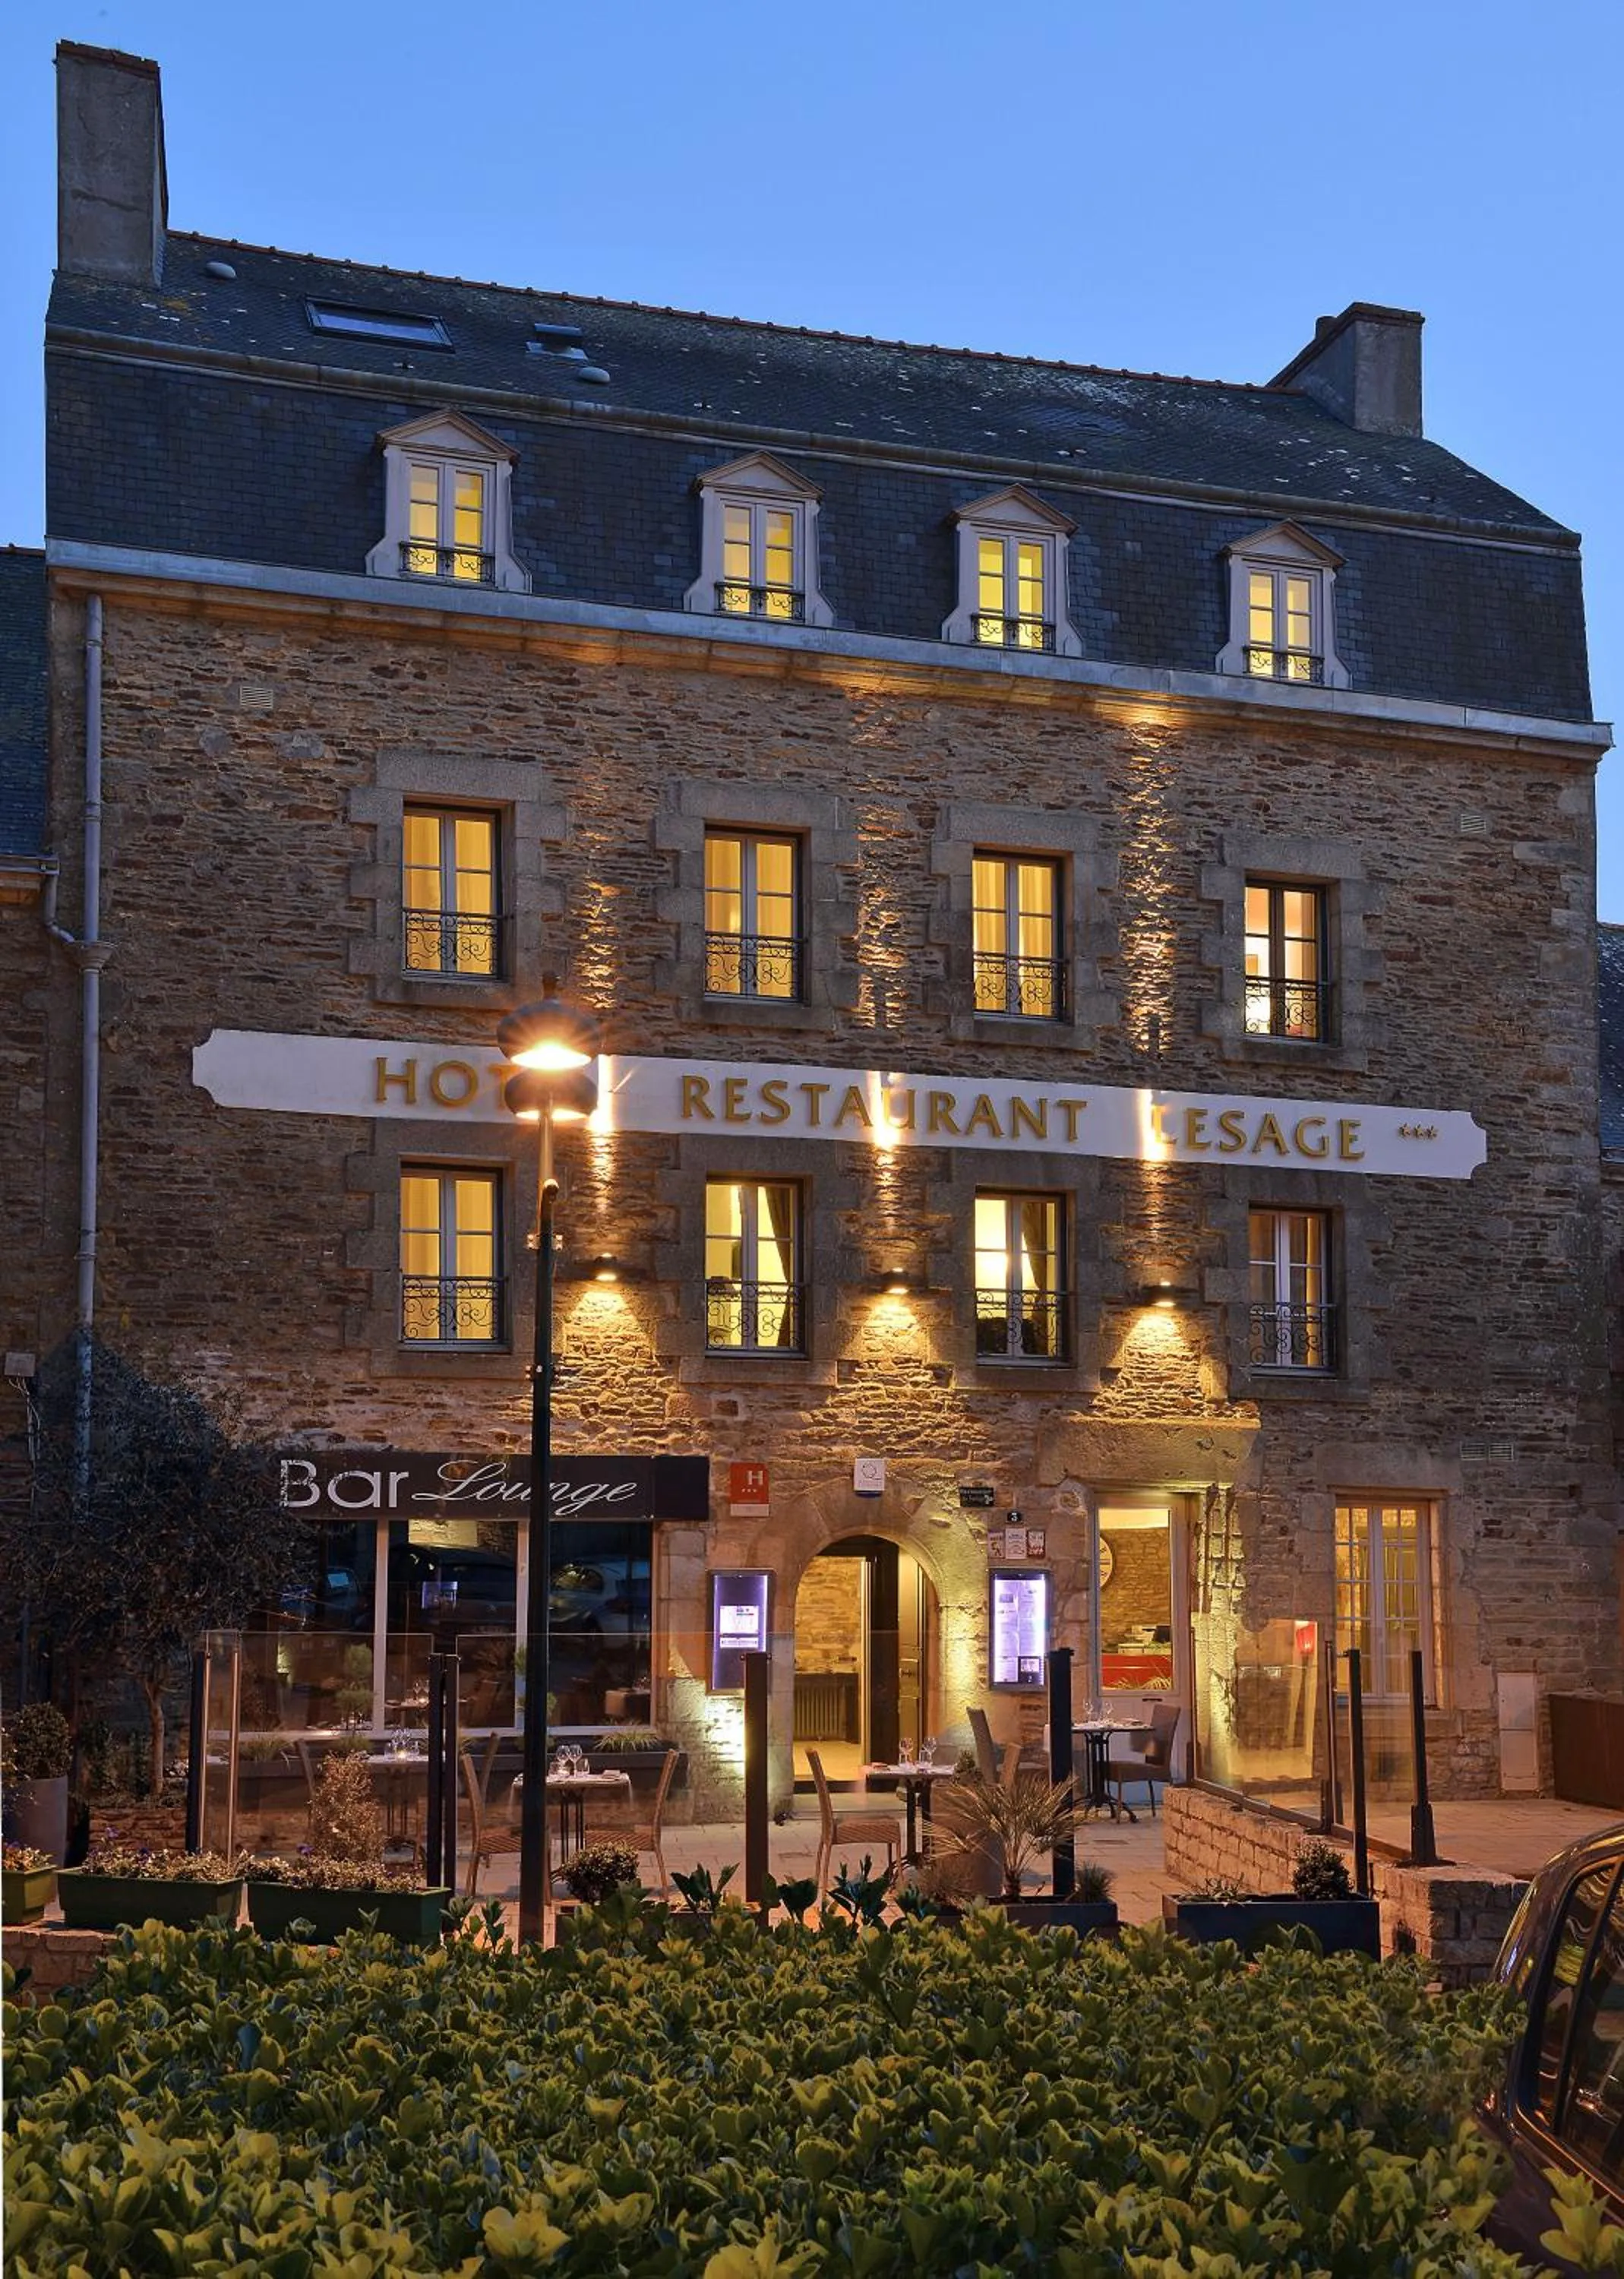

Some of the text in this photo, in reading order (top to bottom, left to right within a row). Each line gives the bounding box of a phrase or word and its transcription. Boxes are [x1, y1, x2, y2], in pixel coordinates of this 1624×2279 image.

[375, 1057, 1365, 1159] HOT RESTAURANT LESAGE
[280, 1459, 637, 1515] Bar Lounge
[747, 1470, 763, 1485] H
